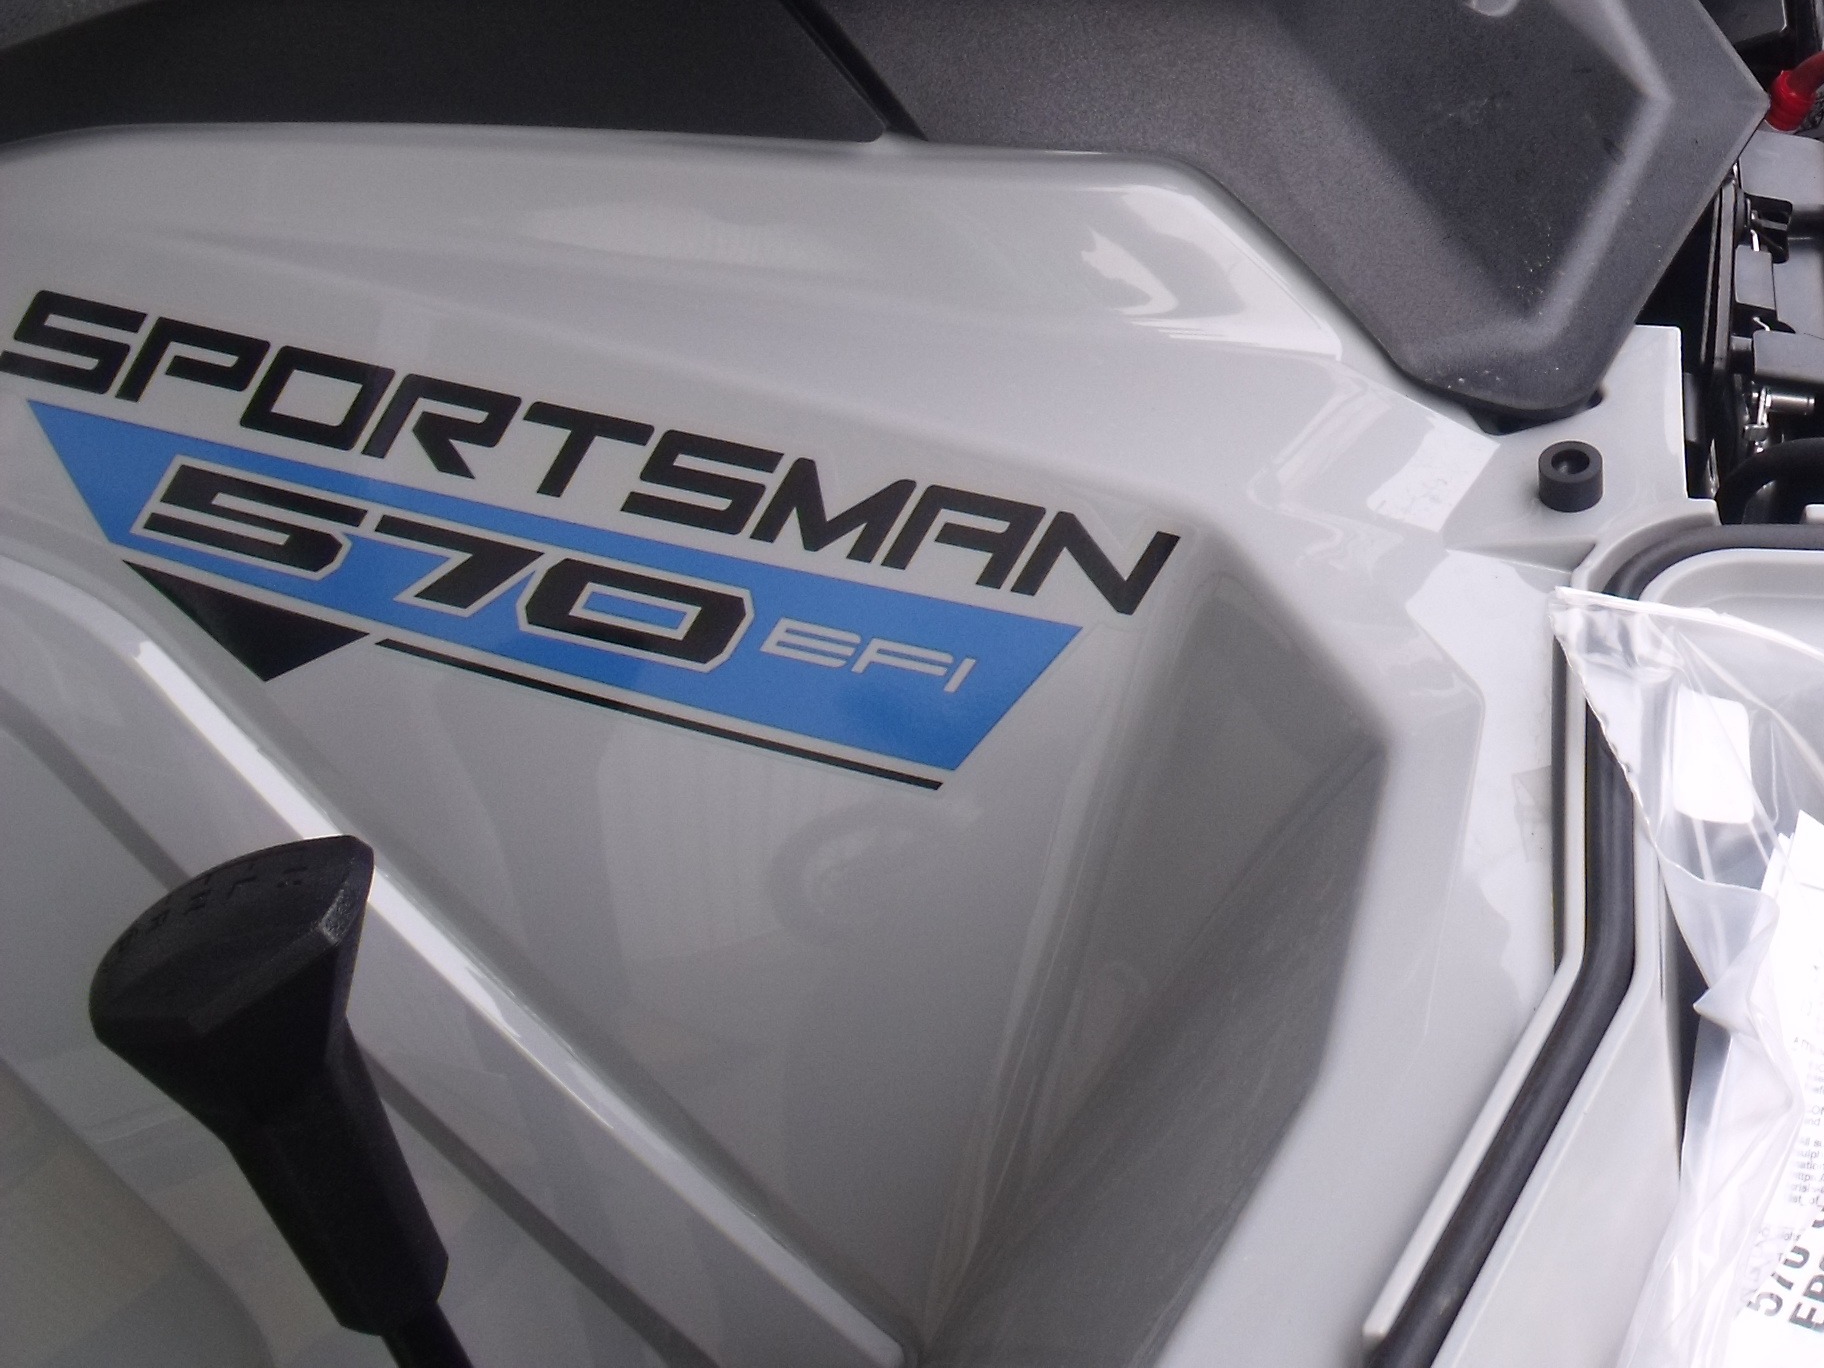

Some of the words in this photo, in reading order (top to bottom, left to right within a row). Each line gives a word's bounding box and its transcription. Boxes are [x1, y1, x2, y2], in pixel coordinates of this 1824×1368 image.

[0, 289, 1183, 616] SPORTSMAN
[139, 457, 747, 671] 570
[760, 620, 979, 694] EFI
